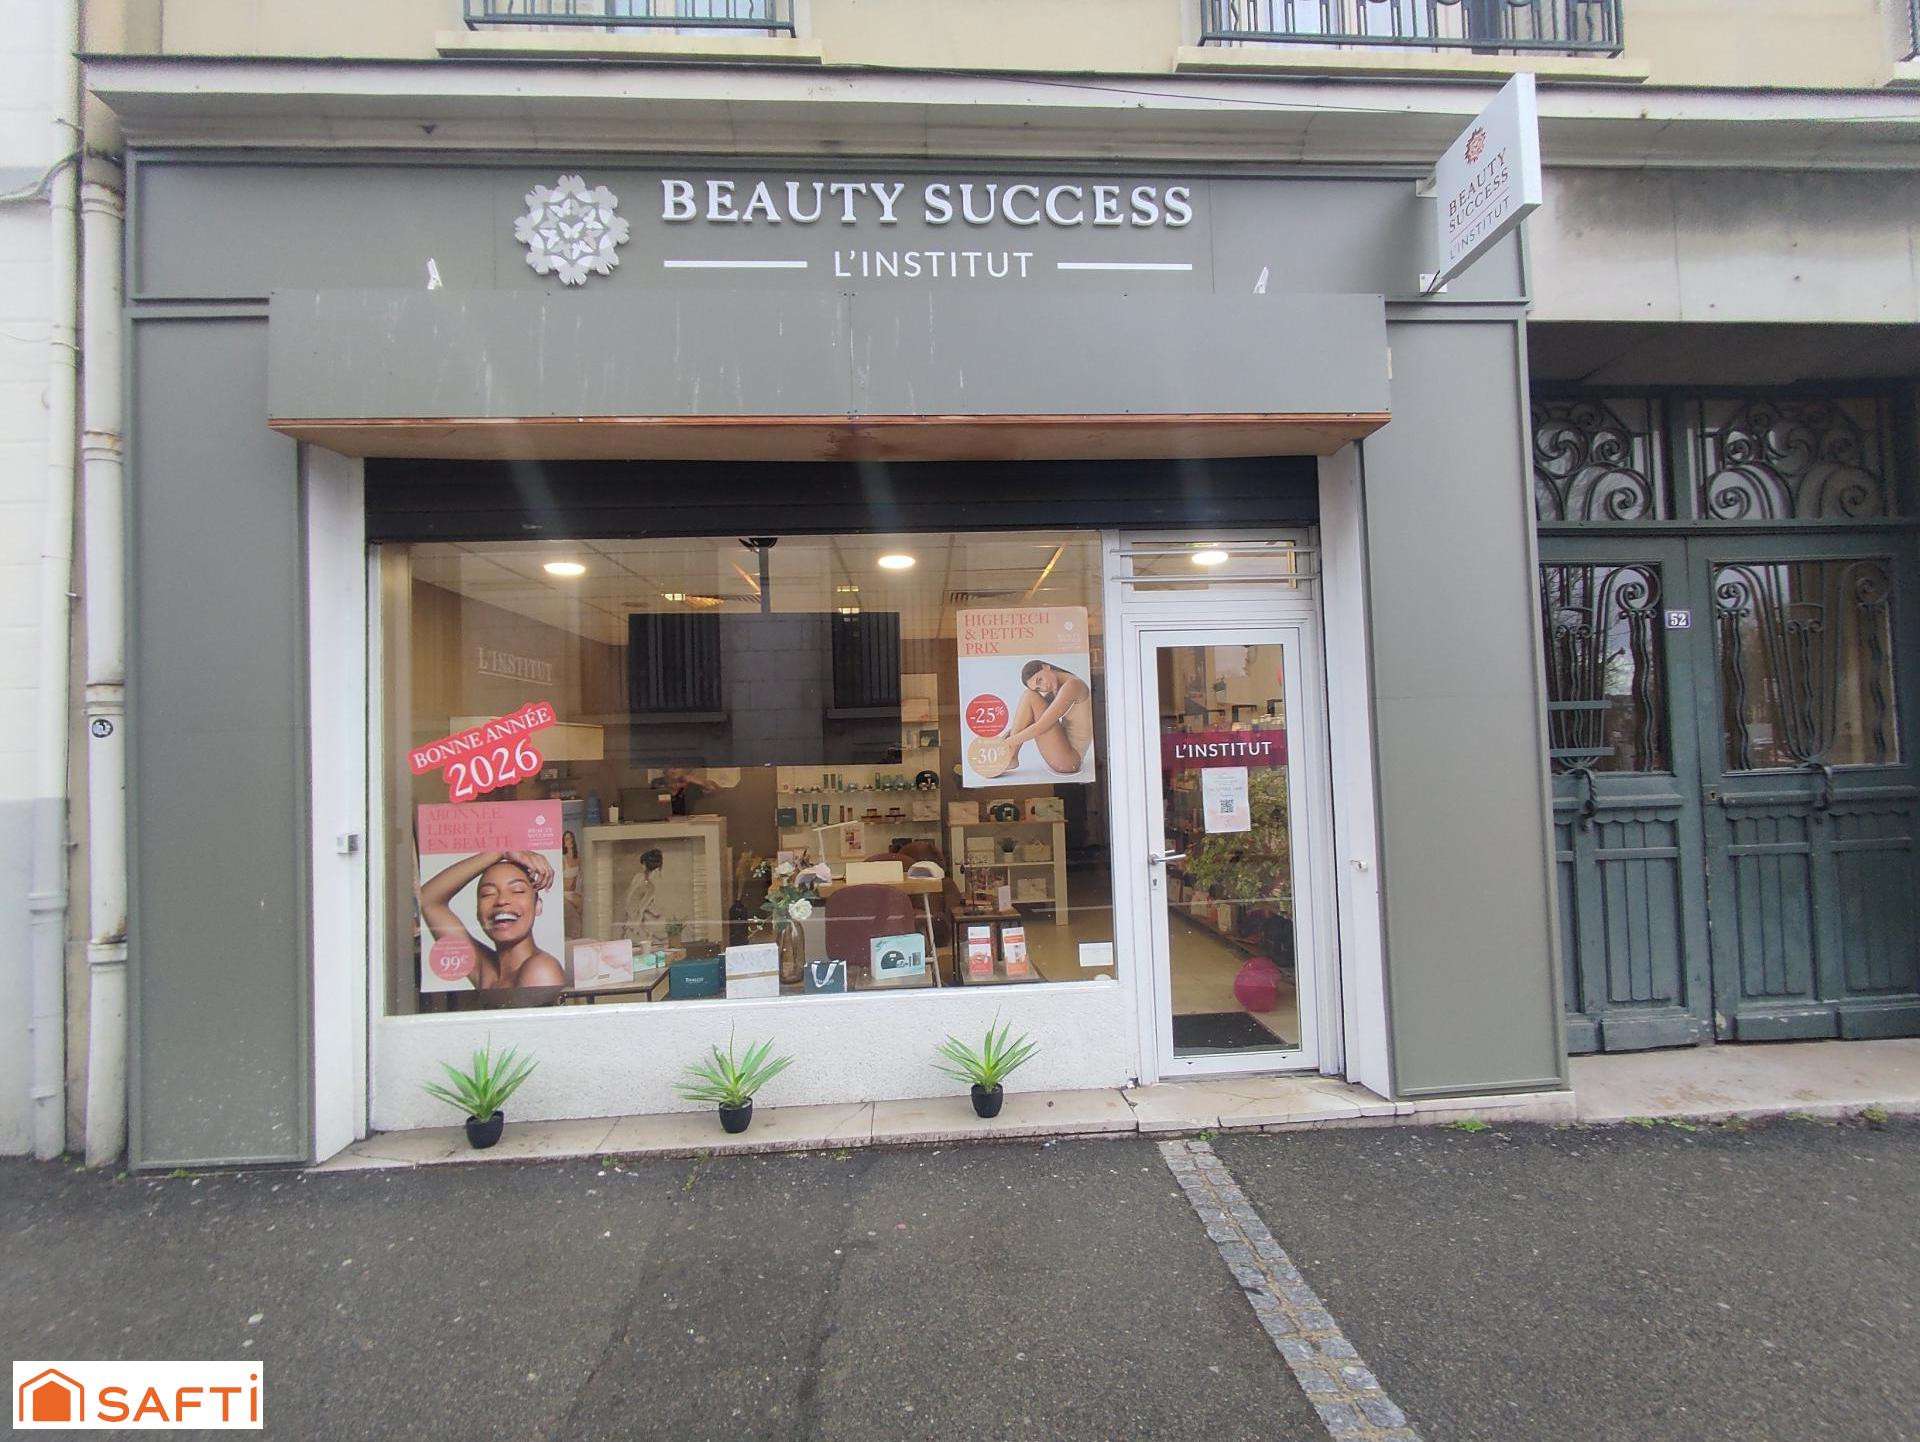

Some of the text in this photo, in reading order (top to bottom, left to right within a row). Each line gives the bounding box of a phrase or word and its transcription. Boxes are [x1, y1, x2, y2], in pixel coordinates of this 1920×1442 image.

[661, 179, 1193, 227] BEAUTY SUCCESS
[1449, 147, 1507, 217] BEAUTY
[1449, 166, 1510, 233] SUCCESS
[1450, 195, 1511, 260] L'INSTITUT
[834, 251, 1034, 278] L'INSTITUT
[964, 627, 1034, 641] & PETITS
[1670, 613, 1687, 626] 52
[965, 641, 1000, 655] PRIX
[413, 707, 551, 769] BONNE ANNÉE
[1175, 741, 1272, 758] L'INSTITUT
[449, 738, 538, 797] 2026
